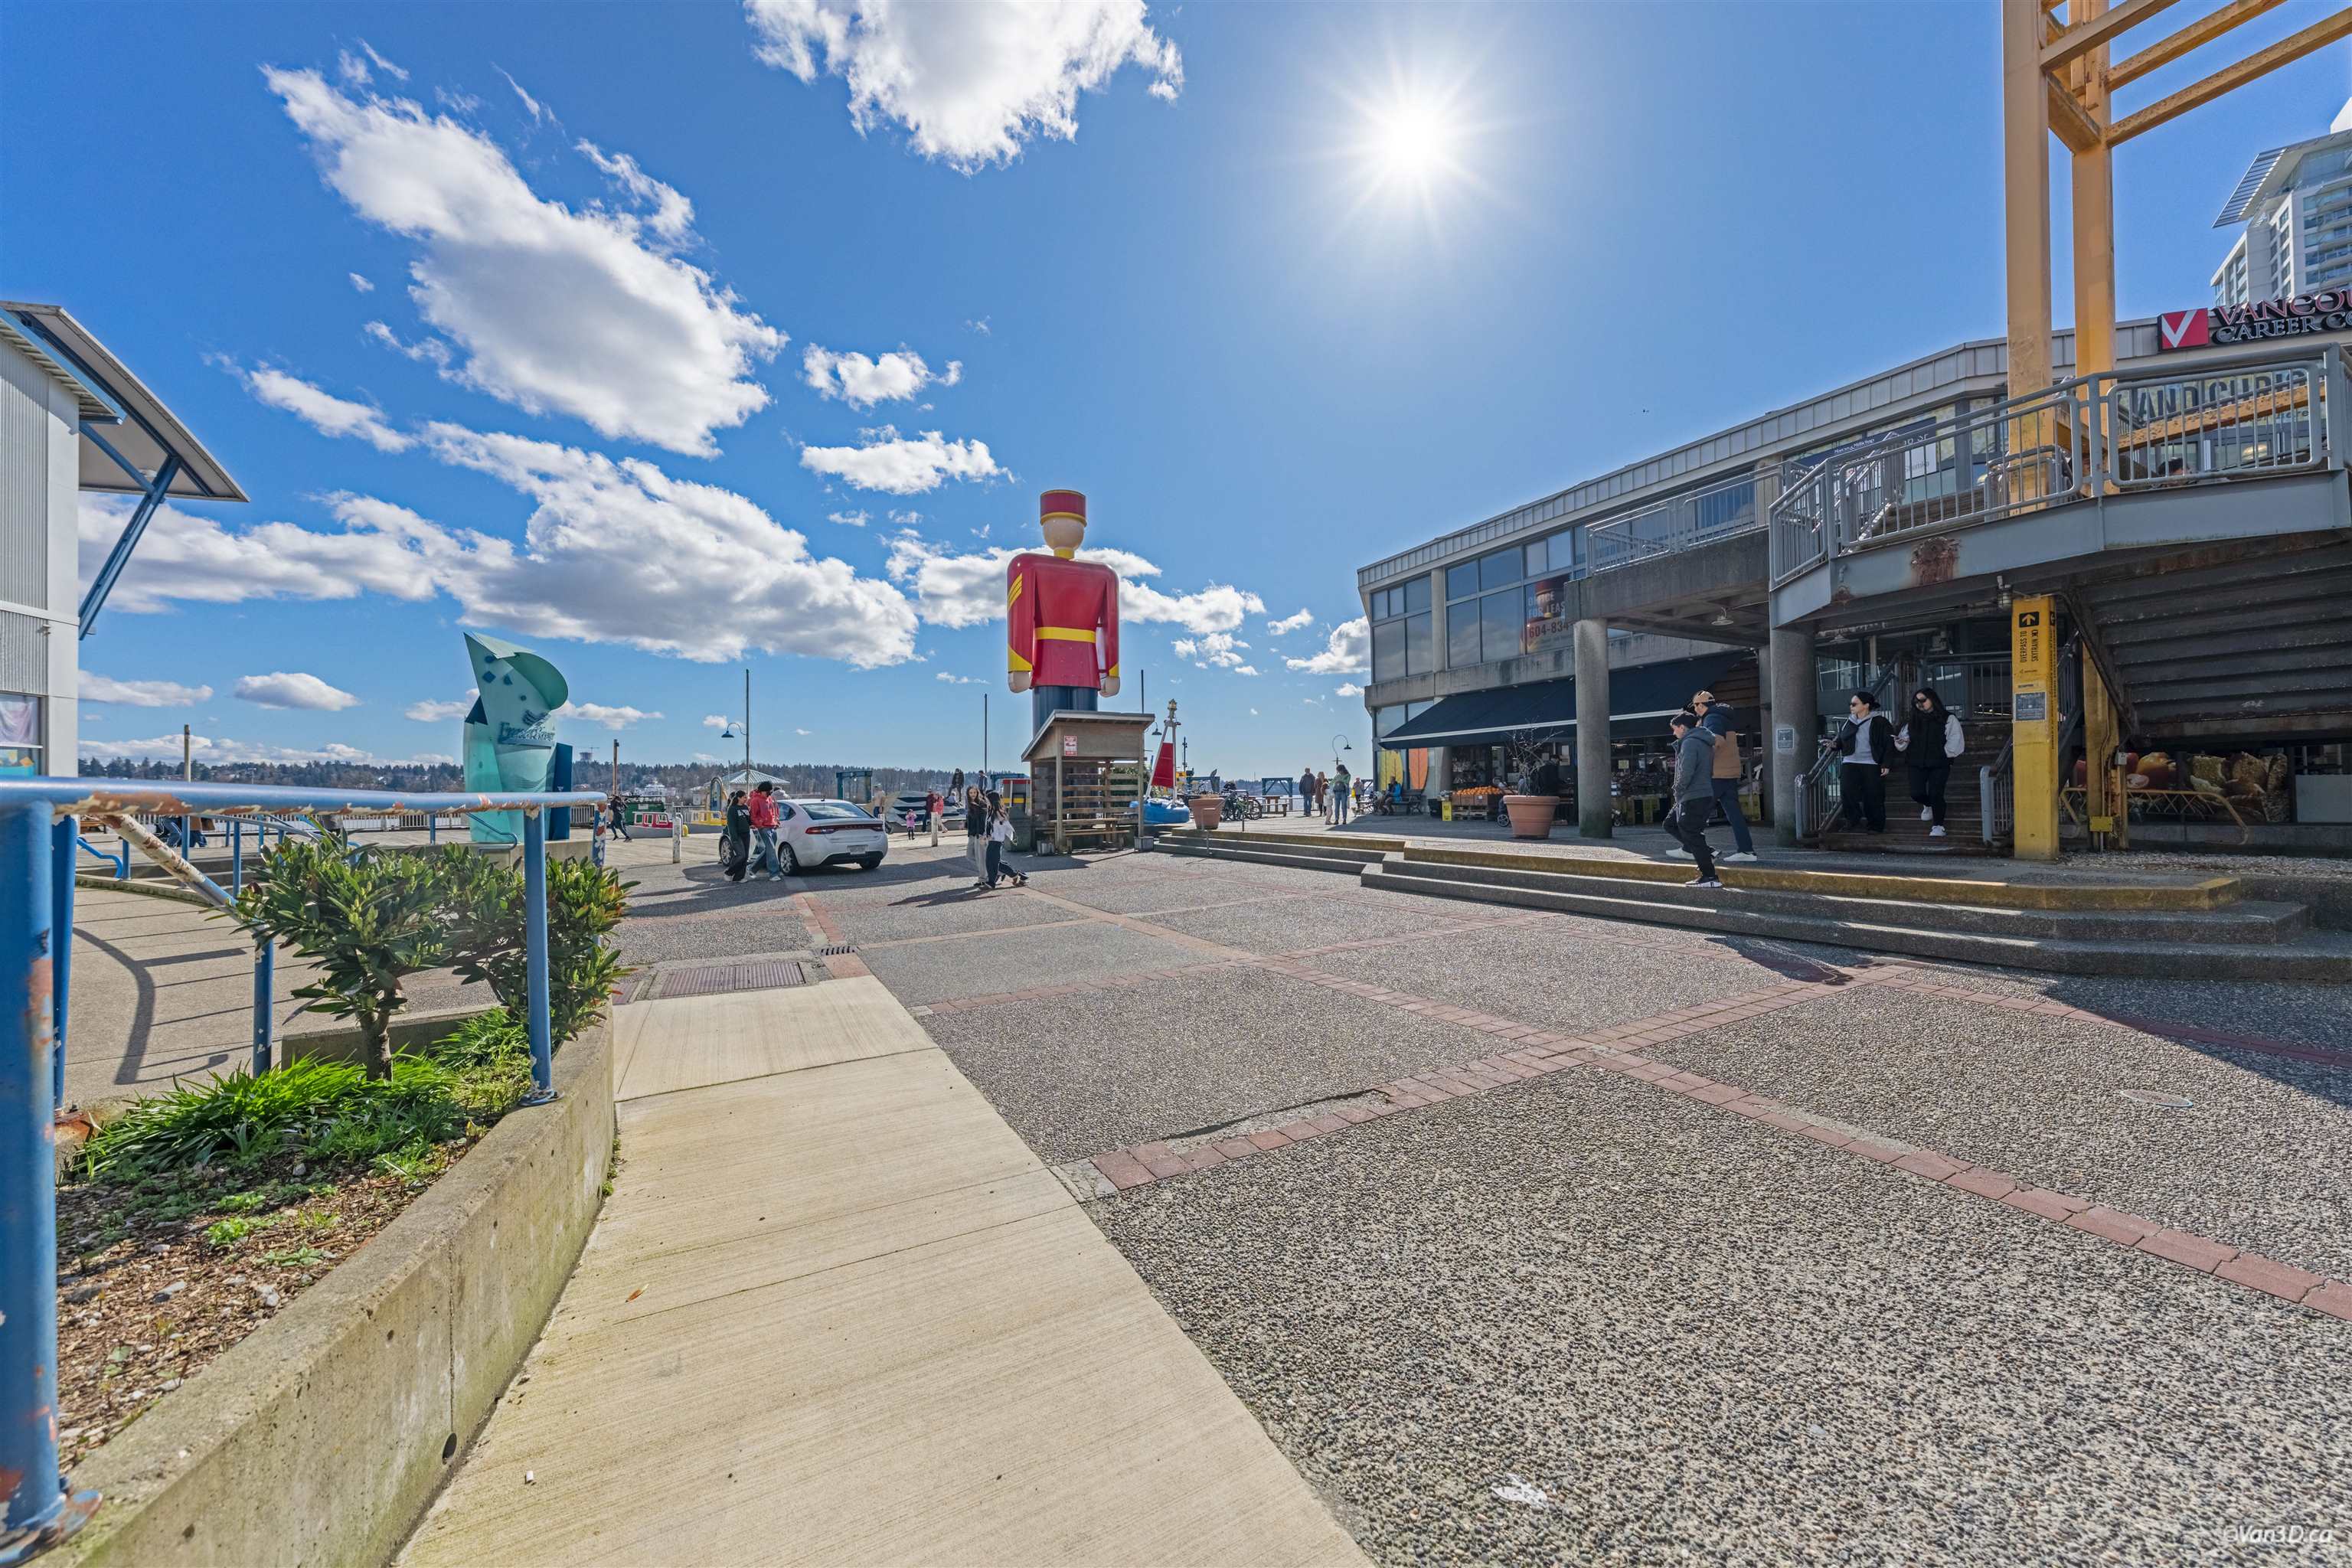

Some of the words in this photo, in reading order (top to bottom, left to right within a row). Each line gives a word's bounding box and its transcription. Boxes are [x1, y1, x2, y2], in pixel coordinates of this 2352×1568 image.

[2216, 315, 2322, 344] CAREER
[2138, 387, 2200, 419] AND
[2031, 638, 2040, 662] SKYTRAIN
